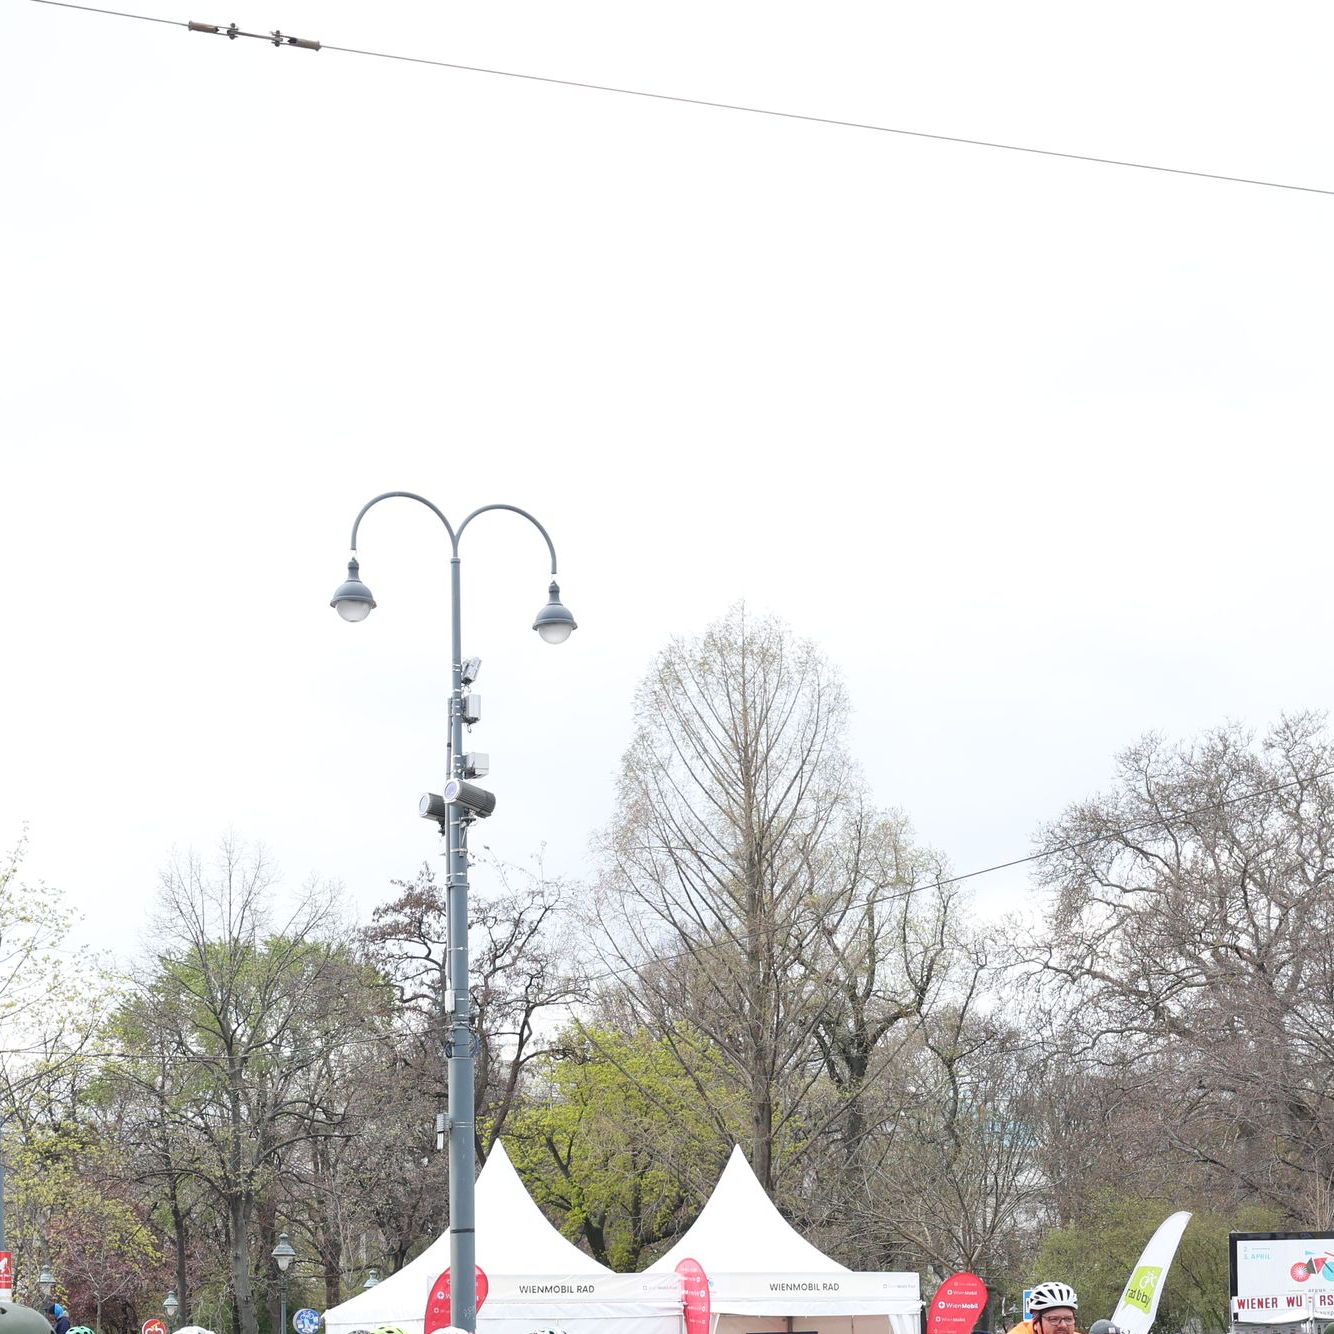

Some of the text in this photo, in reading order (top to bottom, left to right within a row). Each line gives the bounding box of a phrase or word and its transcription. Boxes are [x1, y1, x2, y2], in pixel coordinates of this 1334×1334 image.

[519, 1285, 595, 1294] WIENMOBIL RAD
[769, 1283, 839, 1291] WIENMOBIL RAD
[1238, 1298, 1278, 1309] WIENER
